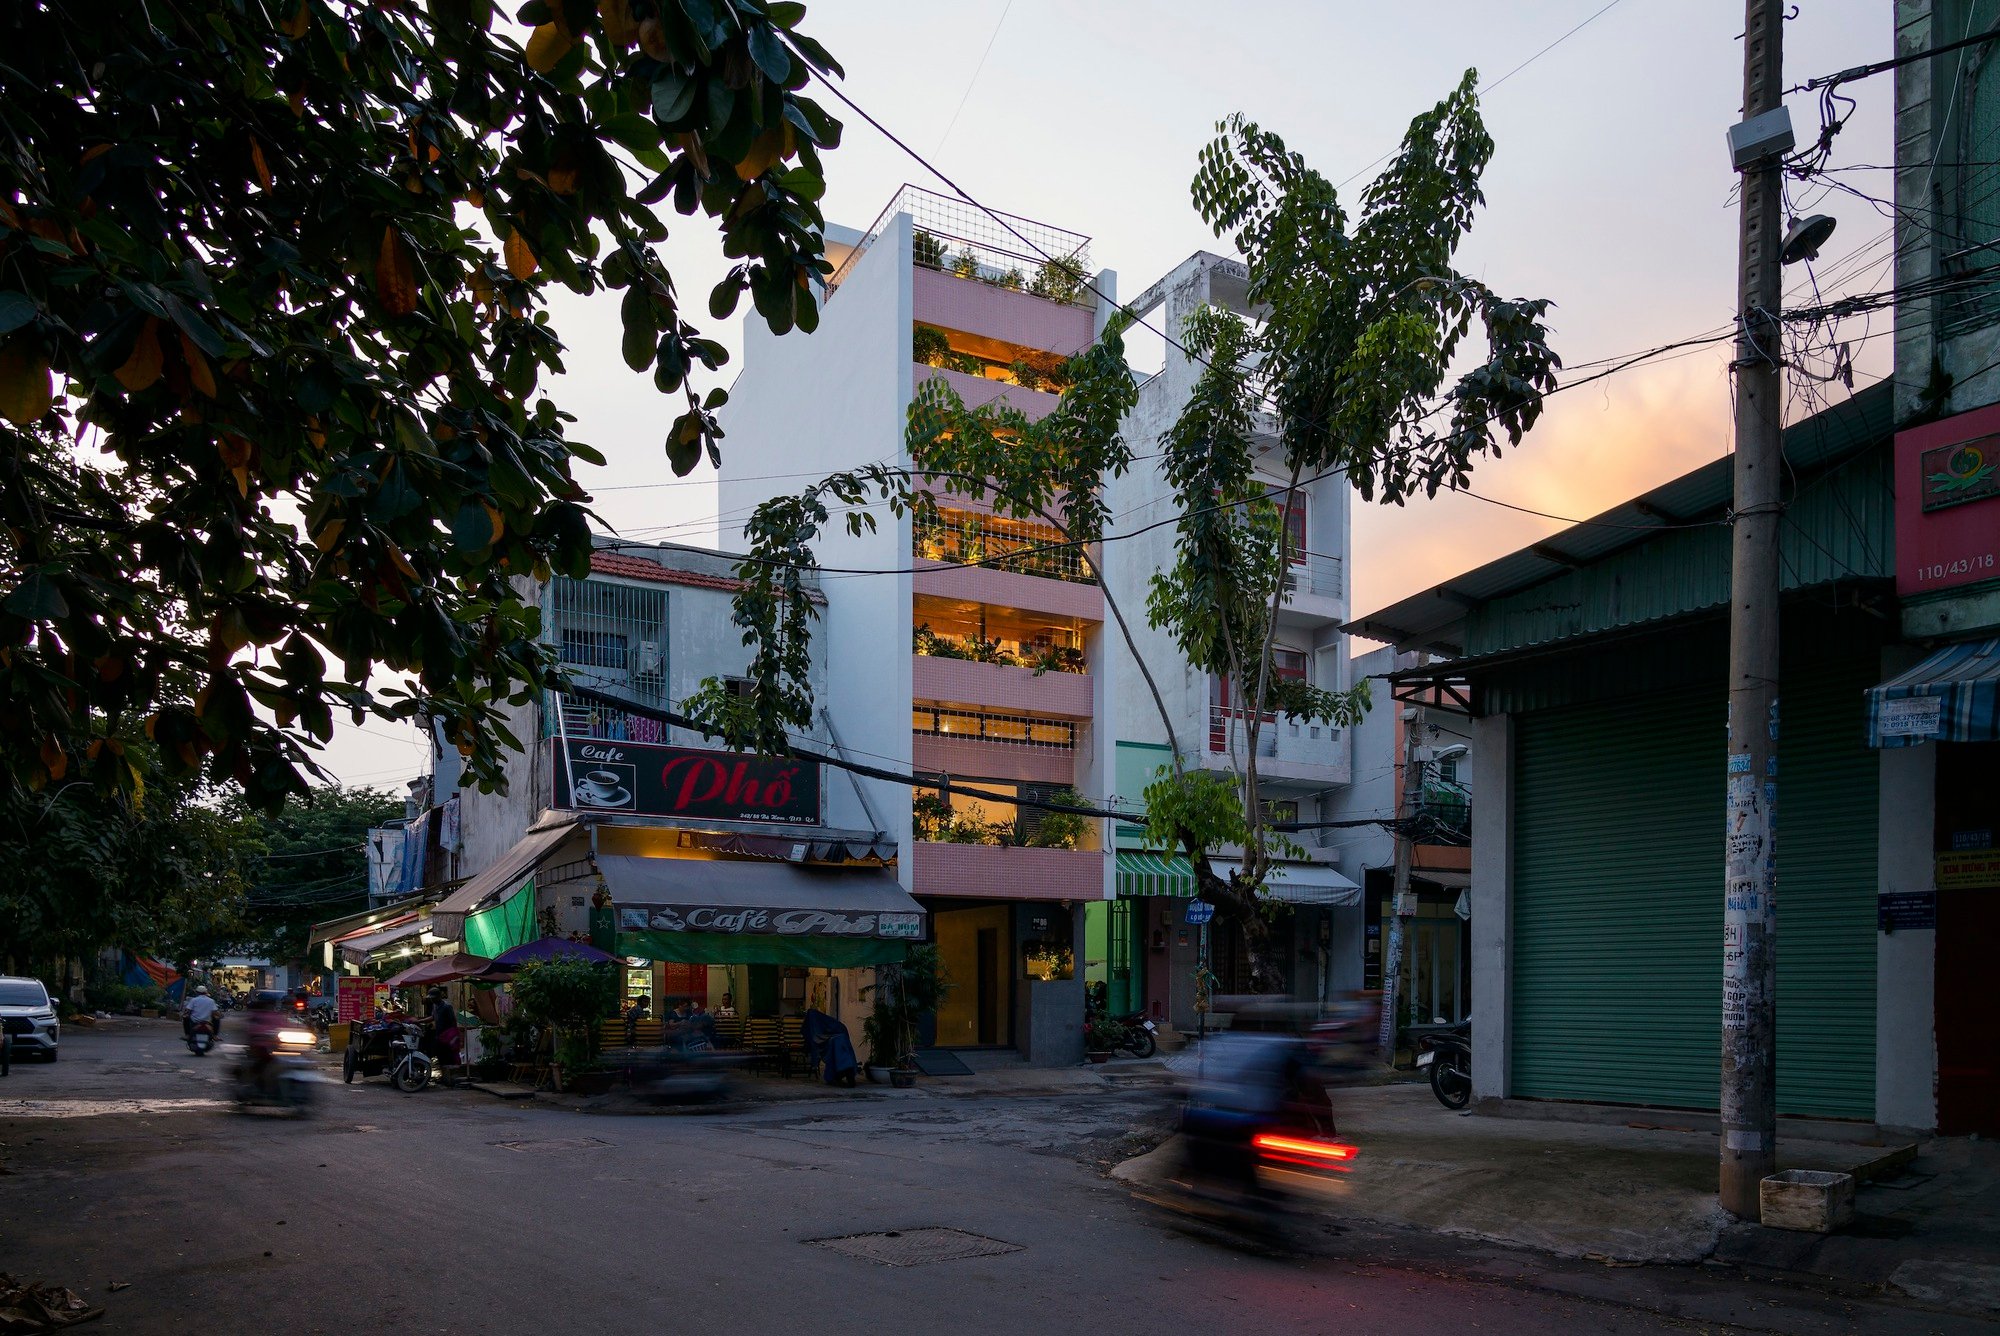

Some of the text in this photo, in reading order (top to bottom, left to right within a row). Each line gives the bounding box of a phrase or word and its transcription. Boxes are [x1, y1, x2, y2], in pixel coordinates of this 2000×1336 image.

[1918, 554, 1994, 581] 110/43/18
[581, 745, 624, 762] Cafe
[662, 756, 799, 810] Phố
[686, 907, 877, 935] Café Phố
